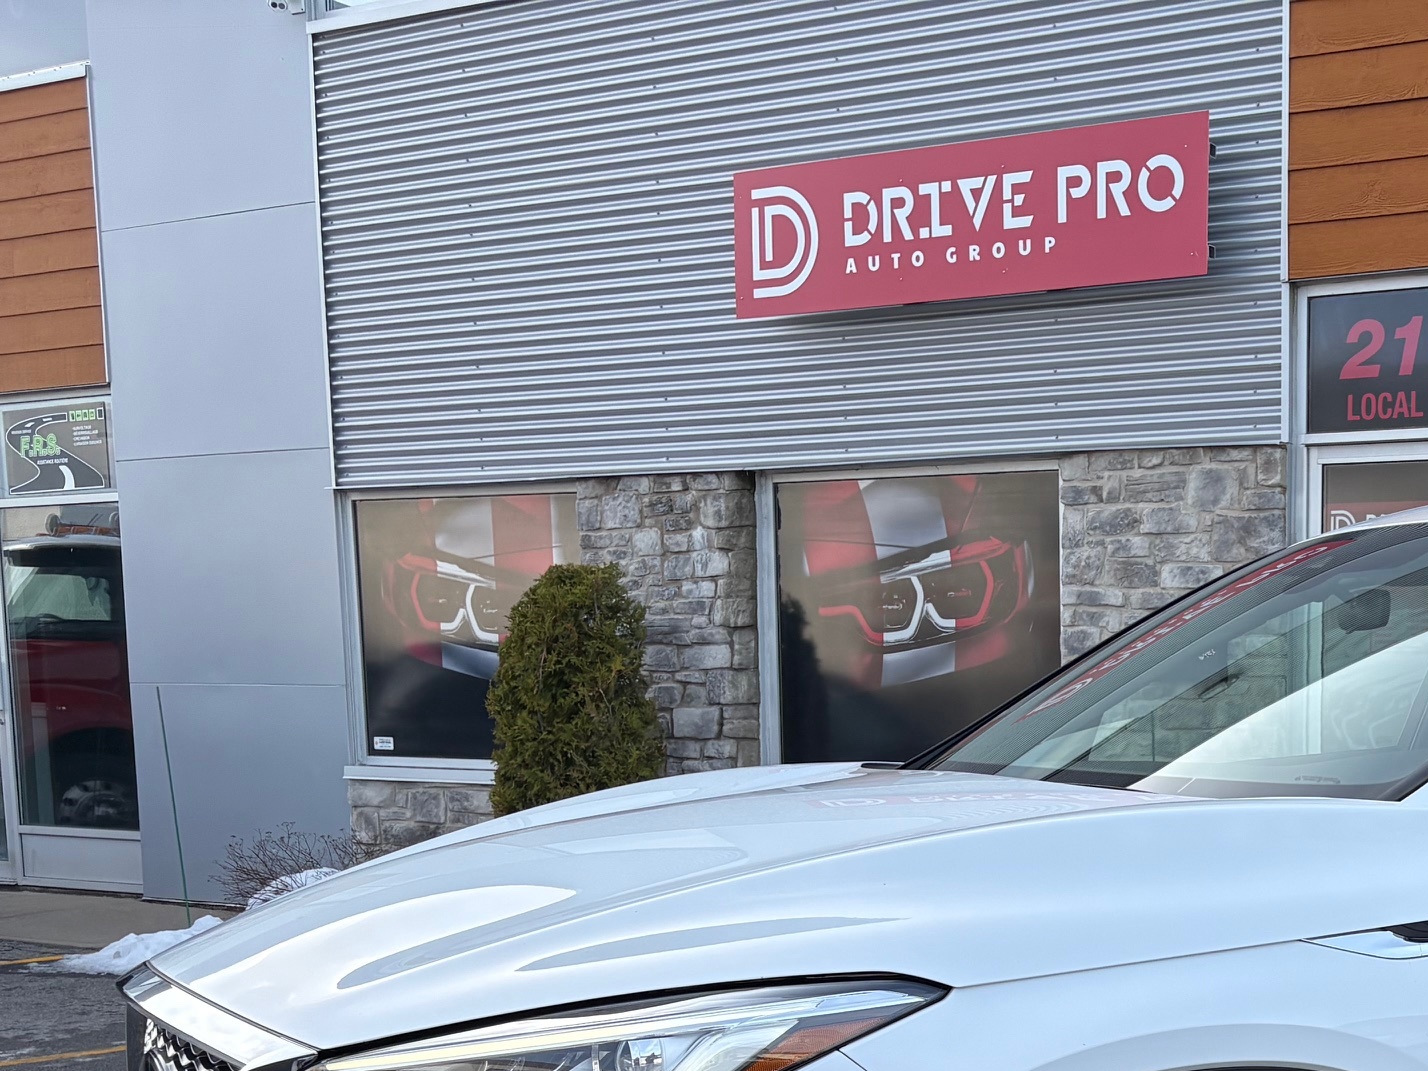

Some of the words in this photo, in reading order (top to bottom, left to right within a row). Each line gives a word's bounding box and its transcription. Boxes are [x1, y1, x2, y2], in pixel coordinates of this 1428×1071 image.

[843, 170, 1034, 247] DRIVE
[1056, 153, 1185, 223] PRO
[845, 250, 926, 274] AUTO
[945, 236, 1057, 263] GROUP
[1346, 390, 1425, 421] LOCAL
